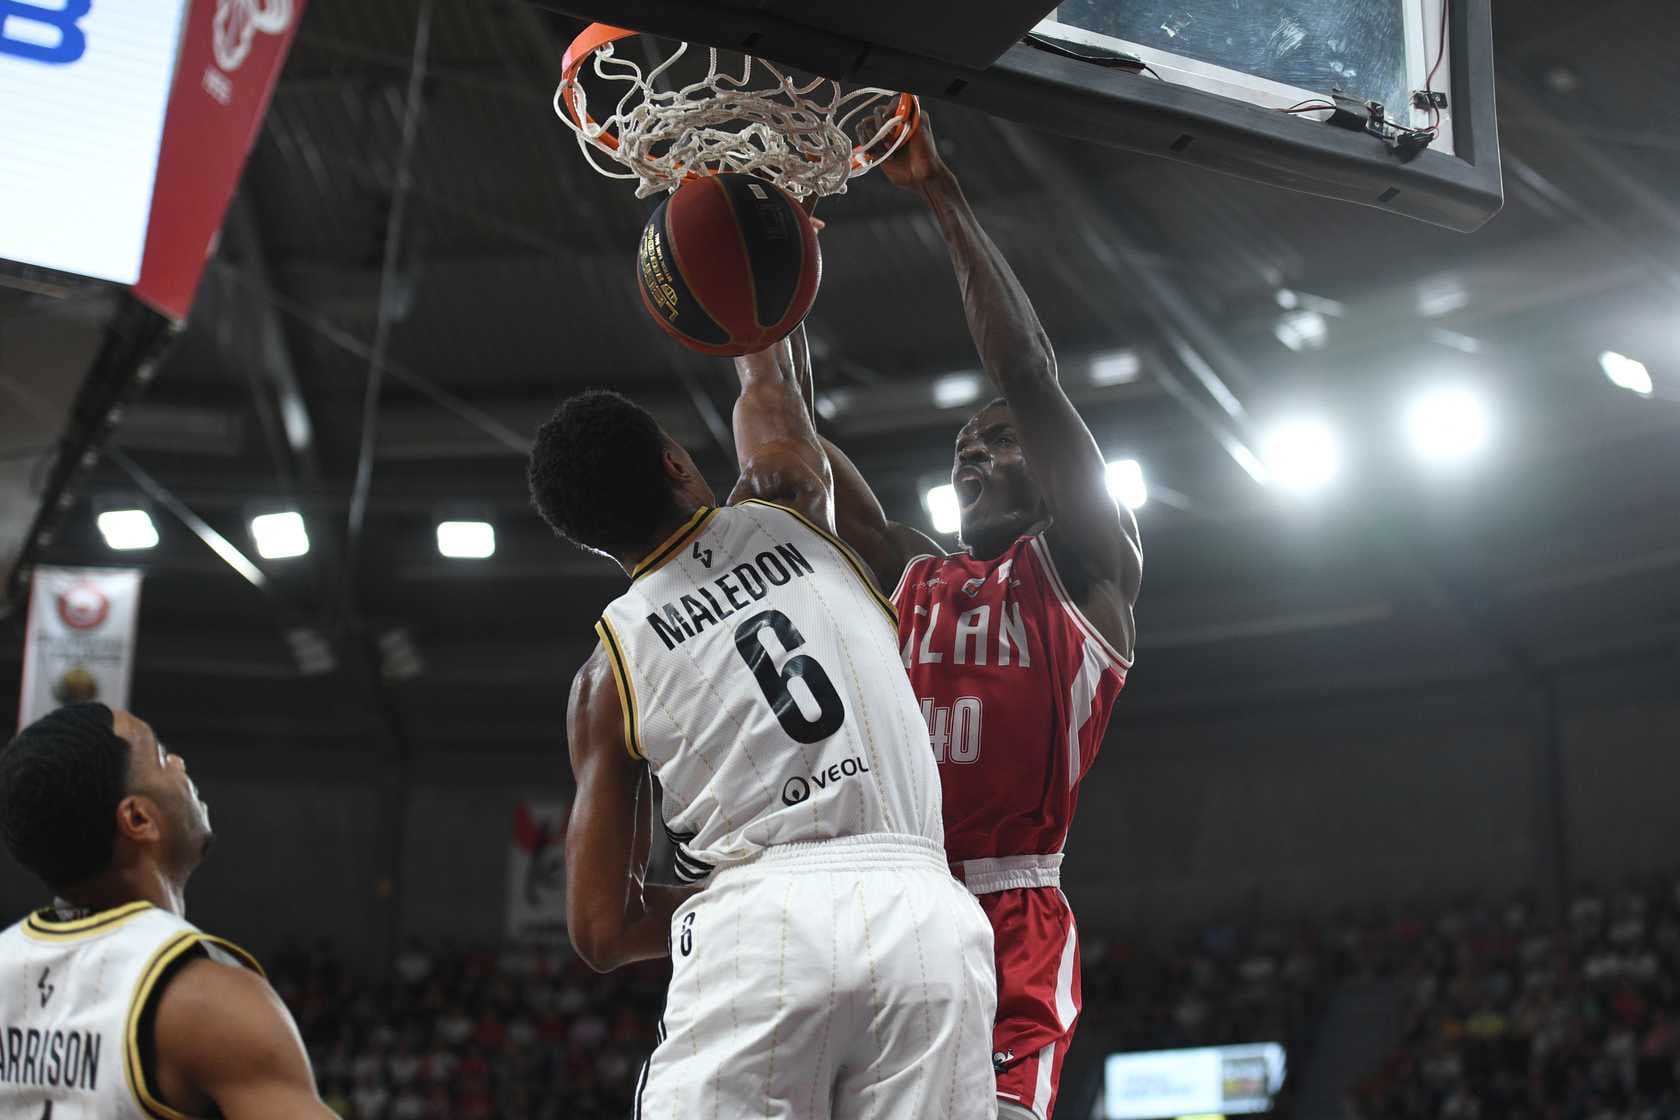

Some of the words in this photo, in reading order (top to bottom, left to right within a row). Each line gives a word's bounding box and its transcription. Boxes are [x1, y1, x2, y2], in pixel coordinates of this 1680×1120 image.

[646, 542, 815, 651] MALEDON
[734, 609, 845, 744] 6
[920, 695, 983, 765] 40
